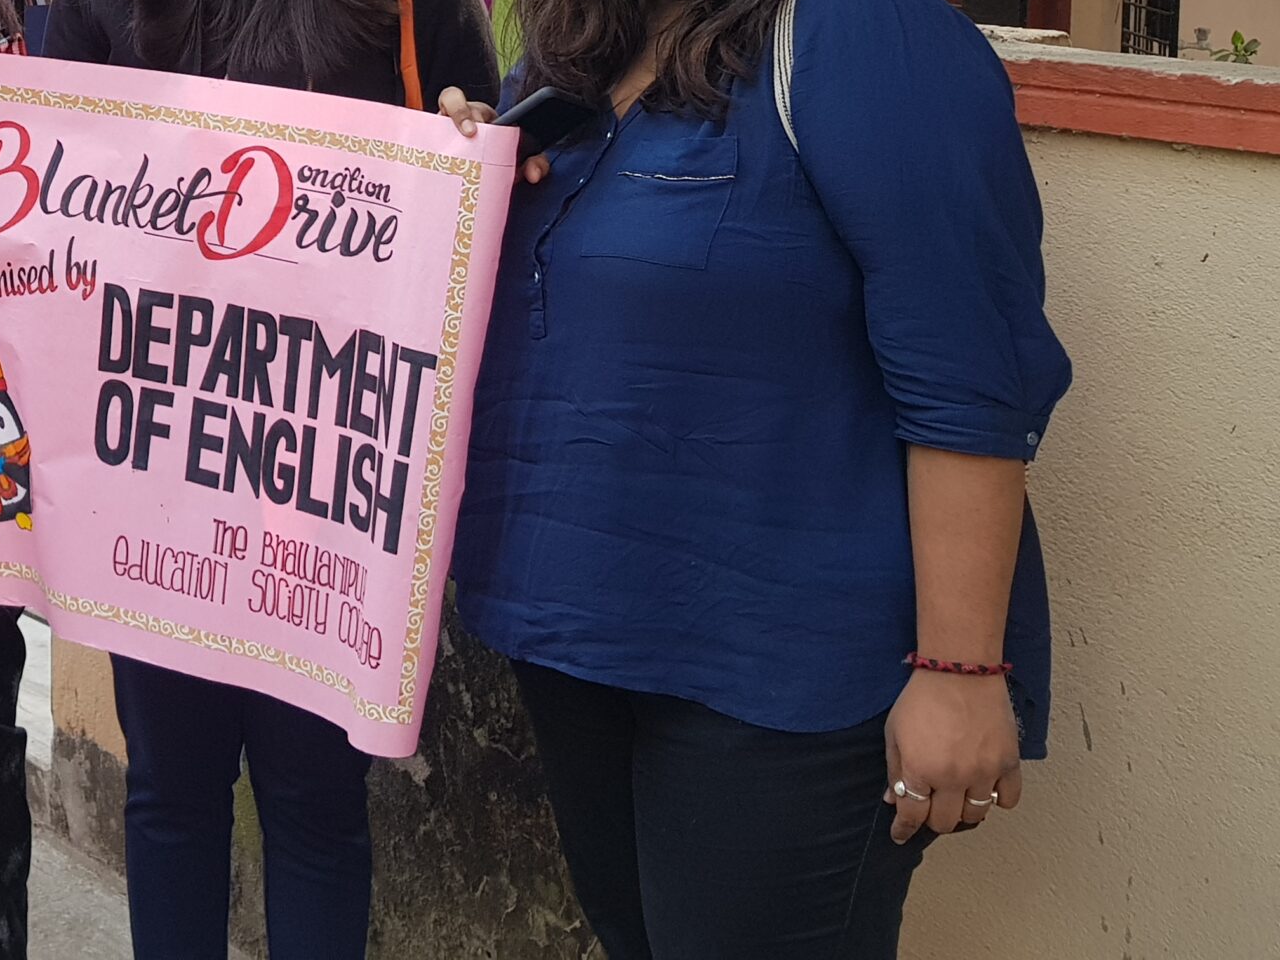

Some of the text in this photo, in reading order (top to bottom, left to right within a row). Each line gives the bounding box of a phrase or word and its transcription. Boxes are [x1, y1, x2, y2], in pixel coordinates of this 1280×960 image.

[196, 145, 400, 263] Drive
[65, 236, 97, 300] by
[98, 282, 438, 458] DEPARTMENT
[94, 379, 410, 555] OF ENGLISH
[212, 518, 248, 561] The
